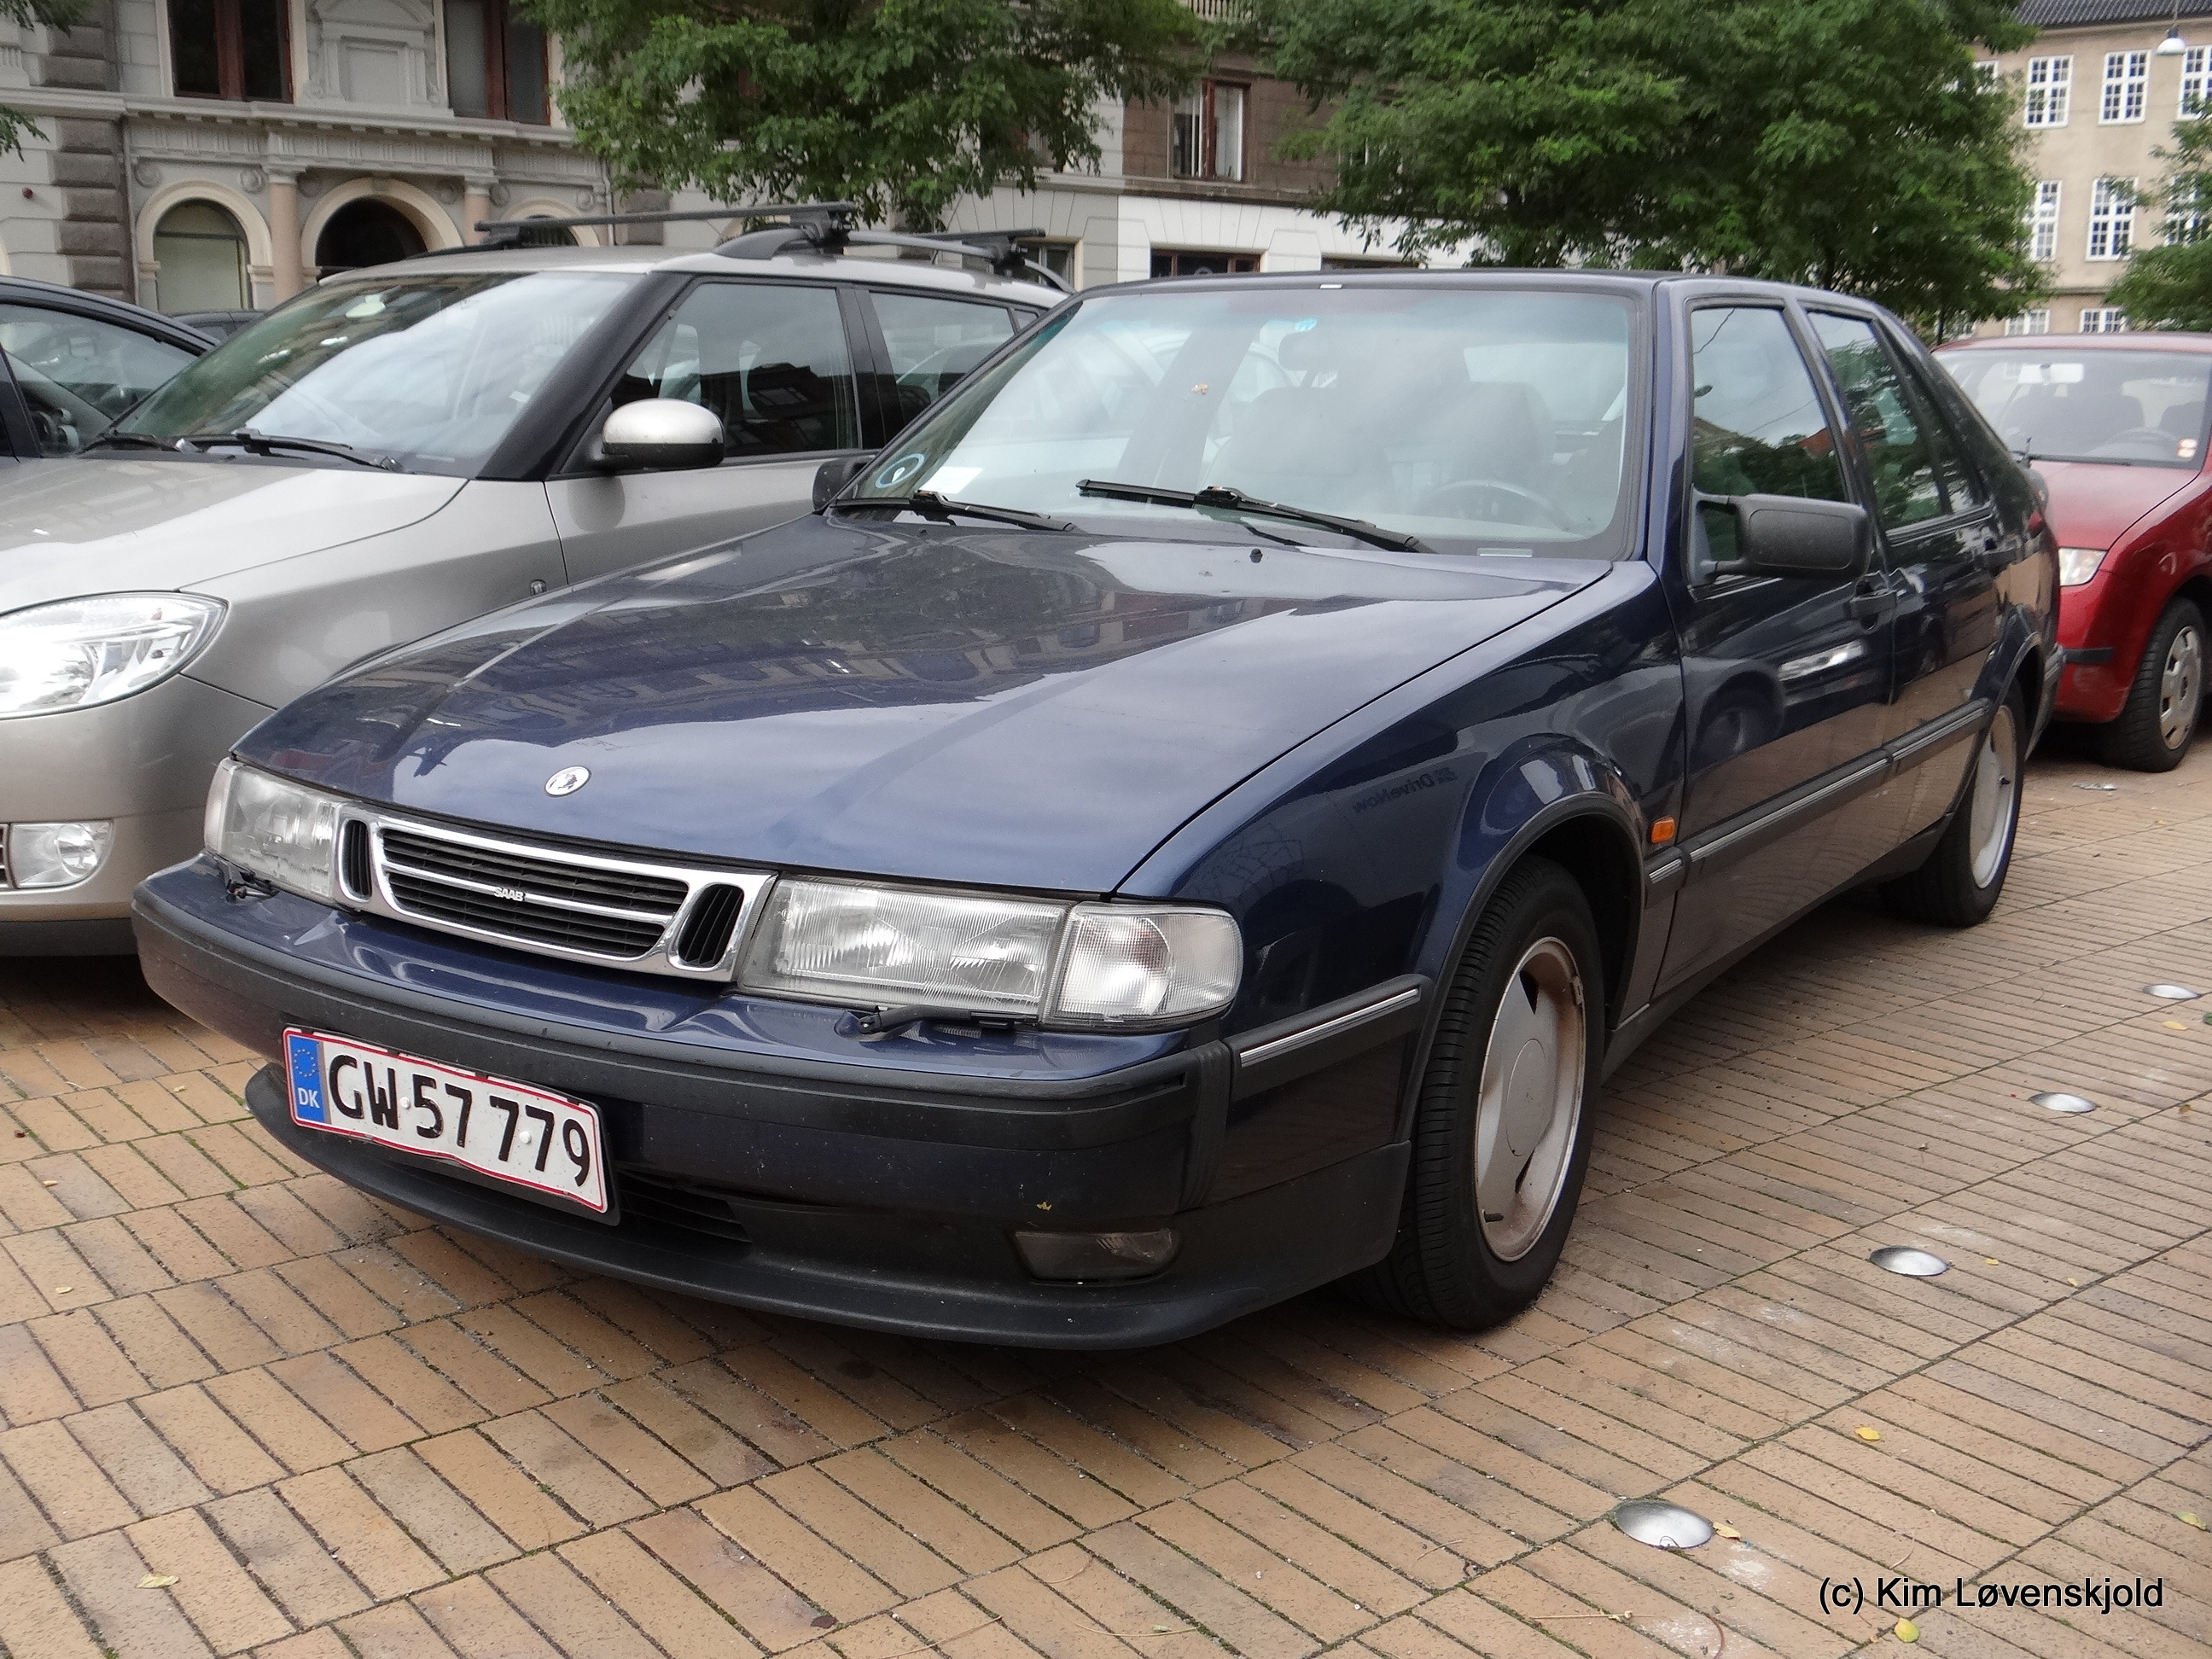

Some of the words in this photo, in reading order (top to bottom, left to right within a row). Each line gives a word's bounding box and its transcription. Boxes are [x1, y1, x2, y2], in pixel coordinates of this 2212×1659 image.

[494, 887, 524, 902] SAAB
[298, 1088, 320, 1109] DK
[329, 1054, 399, 1130] GW
[412, 1074, 472, 1148] 57
[490, 1095, 591, 1187] 779
